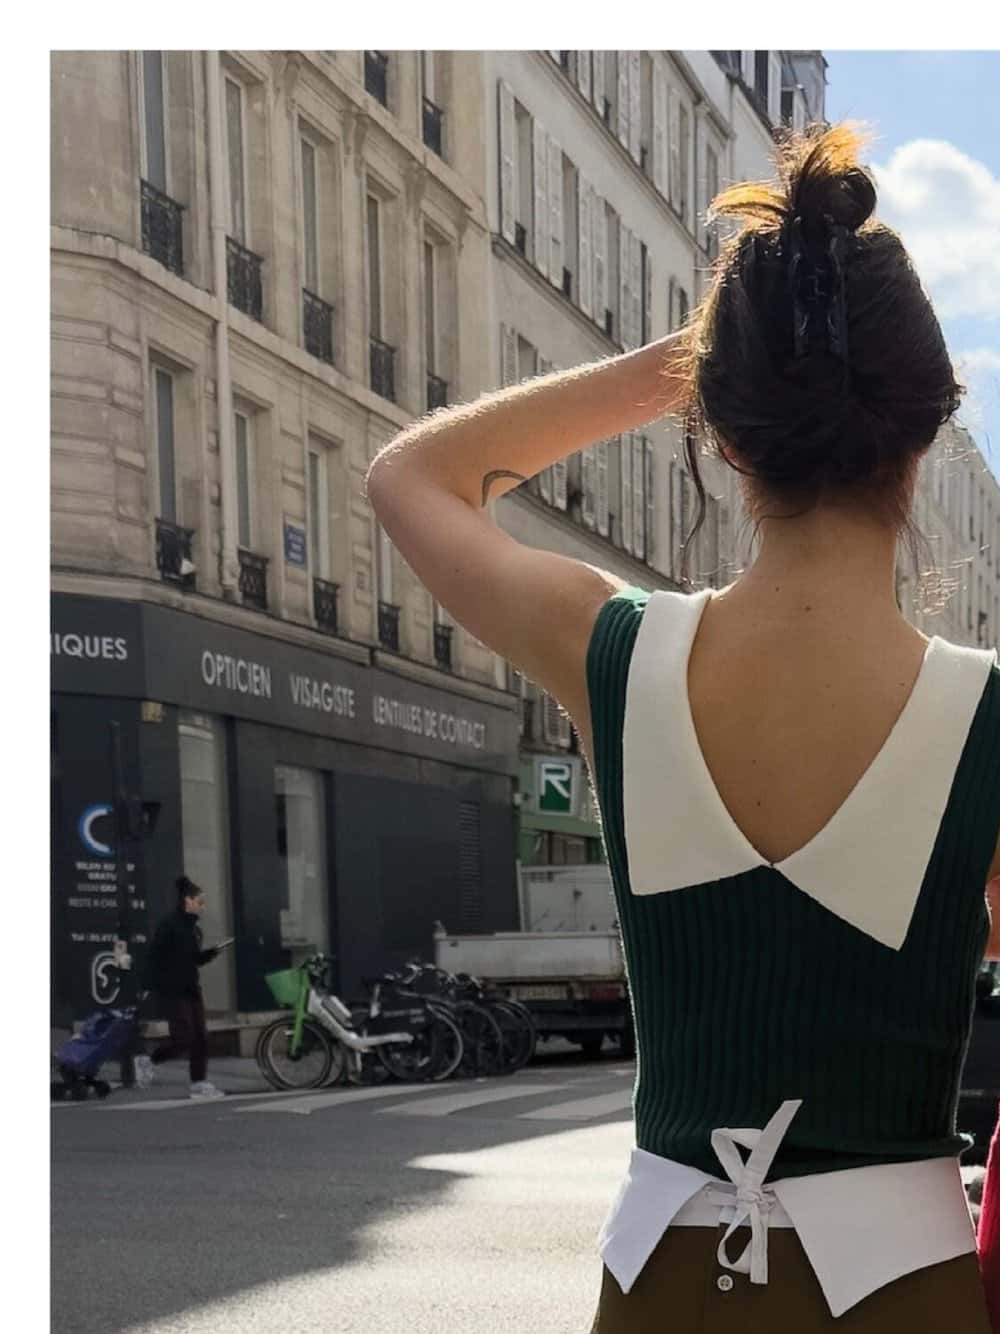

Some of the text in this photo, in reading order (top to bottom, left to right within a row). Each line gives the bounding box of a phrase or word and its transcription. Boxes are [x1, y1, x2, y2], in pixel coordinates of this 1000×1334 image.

[50, 633, 128, 660] IQUES
[202, 651, 485, 749] OPTICIEN VISAGISTE LENTILLES DE CONTACT
[541, 763, 570, 799] R
